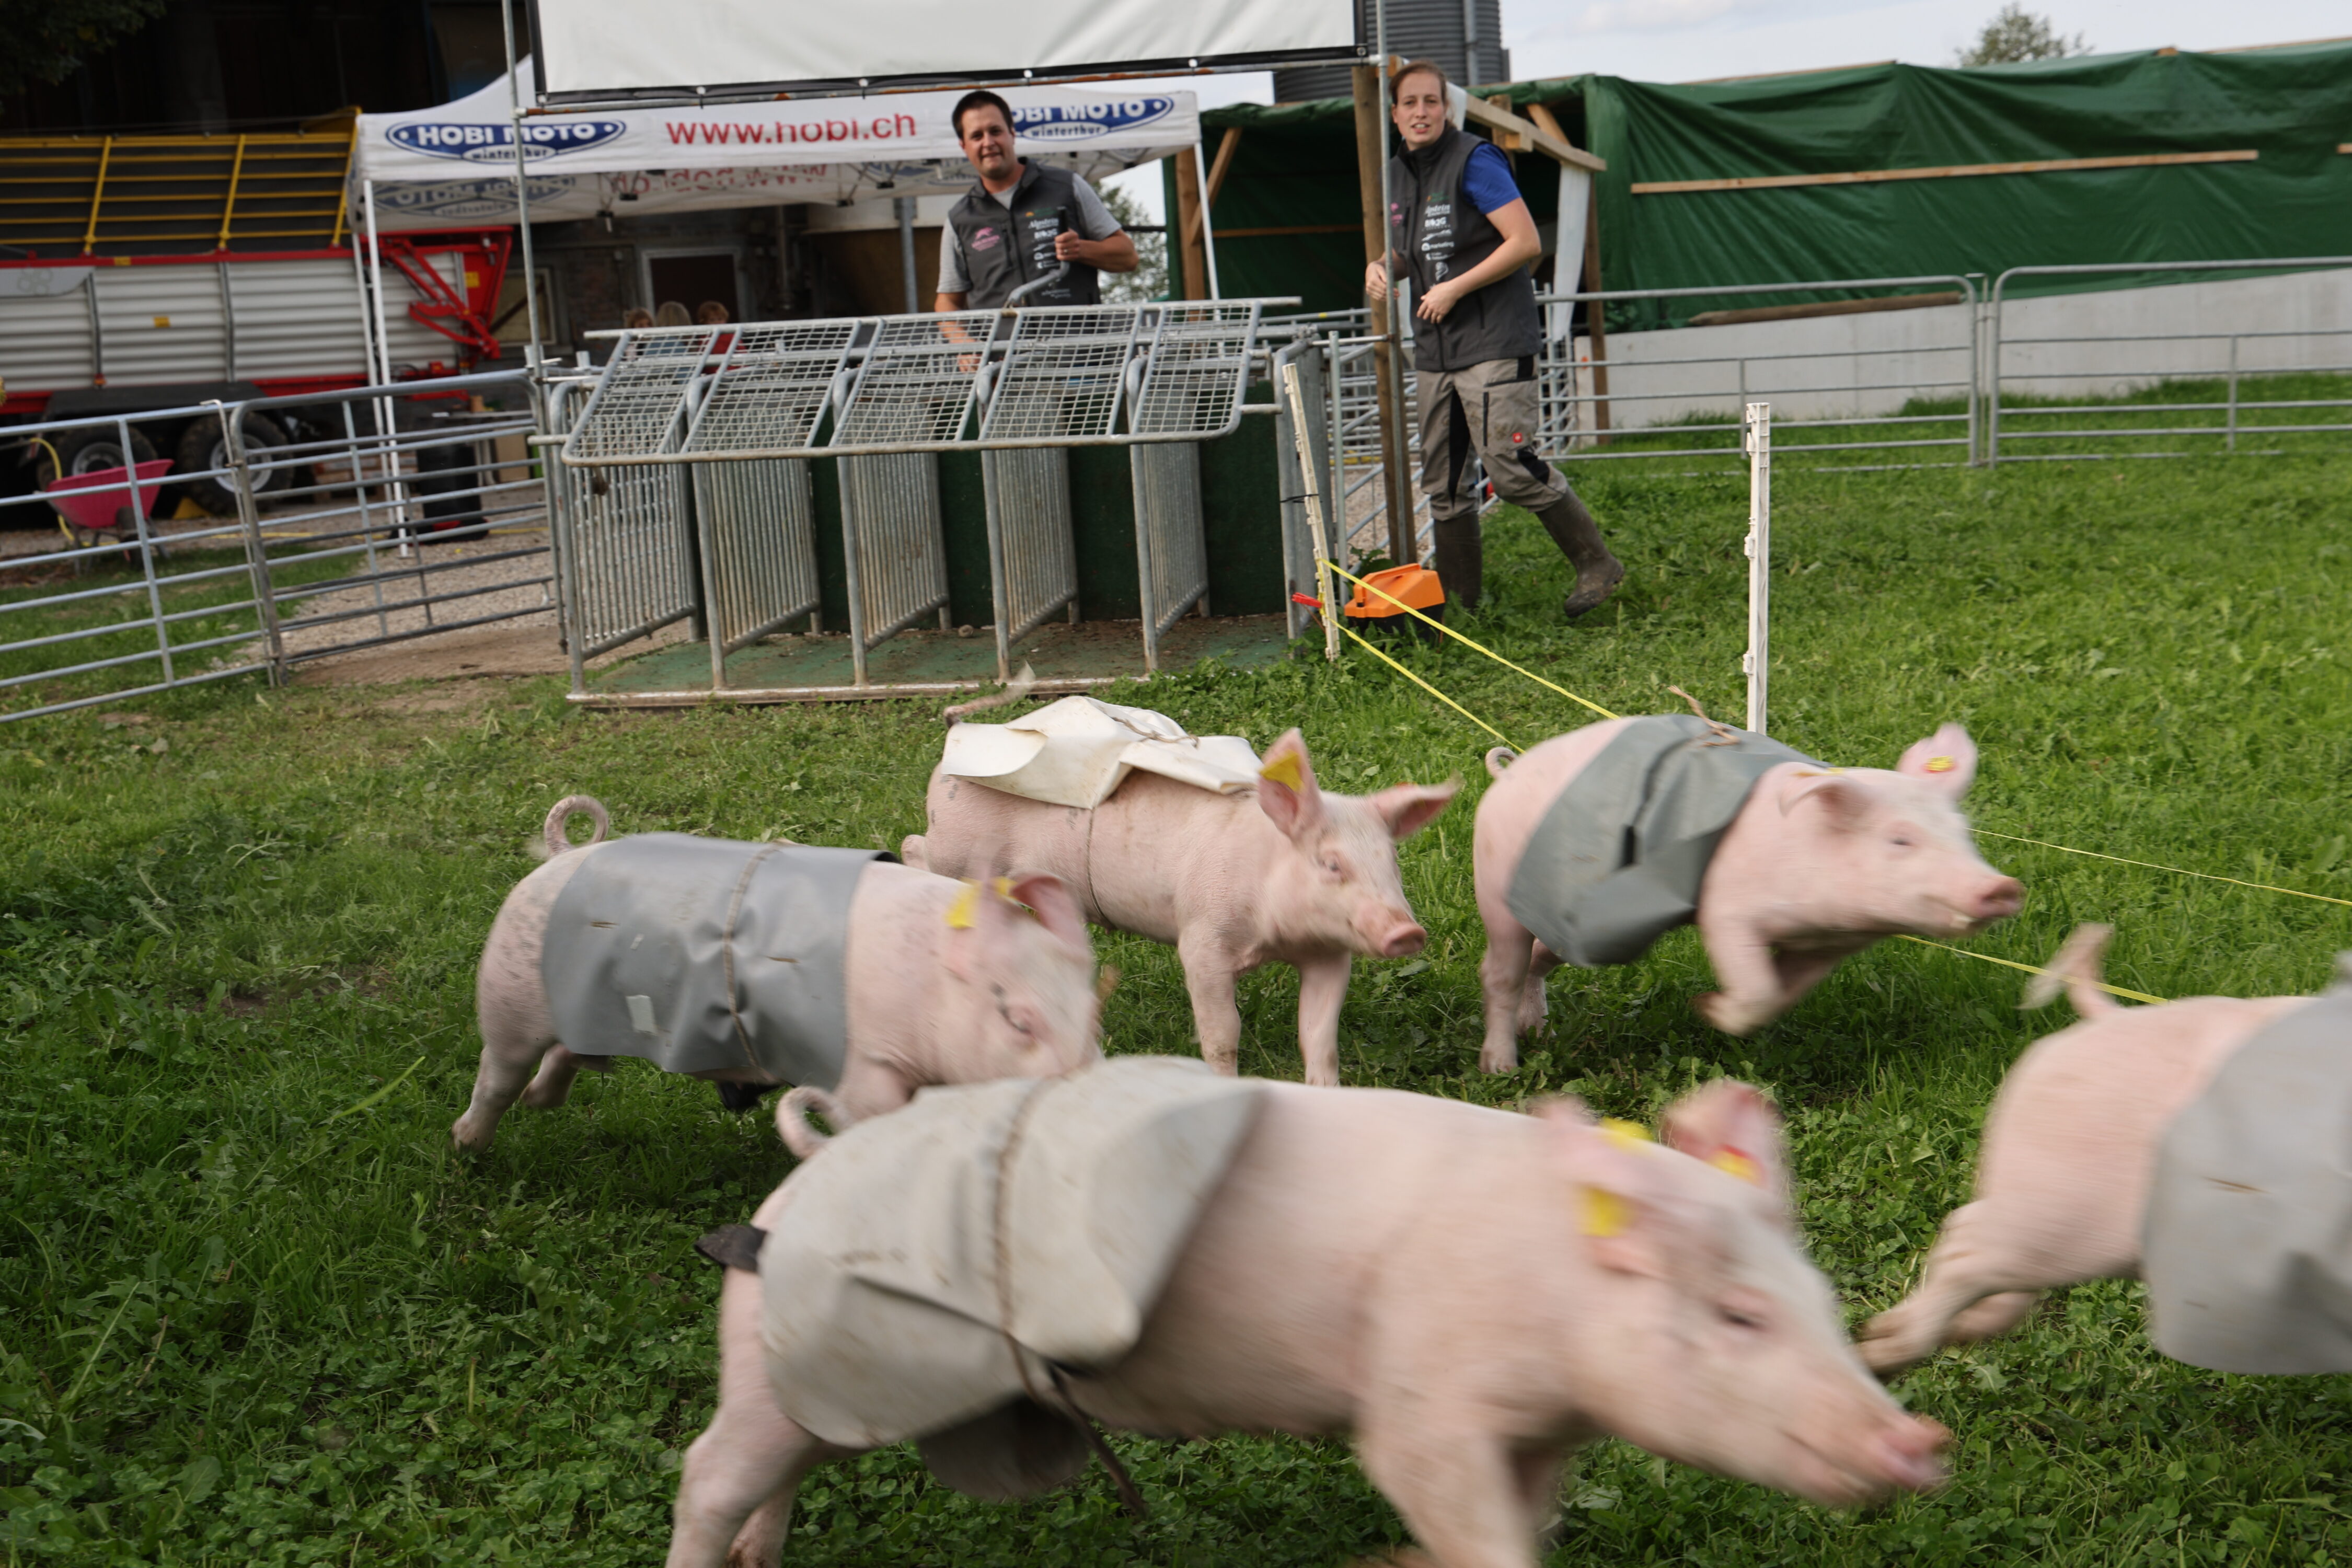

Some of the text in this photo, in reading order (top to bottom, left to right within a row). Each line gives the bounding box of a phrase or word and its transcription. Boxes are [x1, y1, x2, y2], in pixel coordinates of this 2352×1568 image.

[1012, 100, 1146, 122] OBI MOTO
[418, 123, 596, 146] HOBI MOTO
[666, 113, 916, 144] www.hobi.ch
[1031, 124, 1101, 137] winterthur
[472, 147, 547, 159] winterhur
